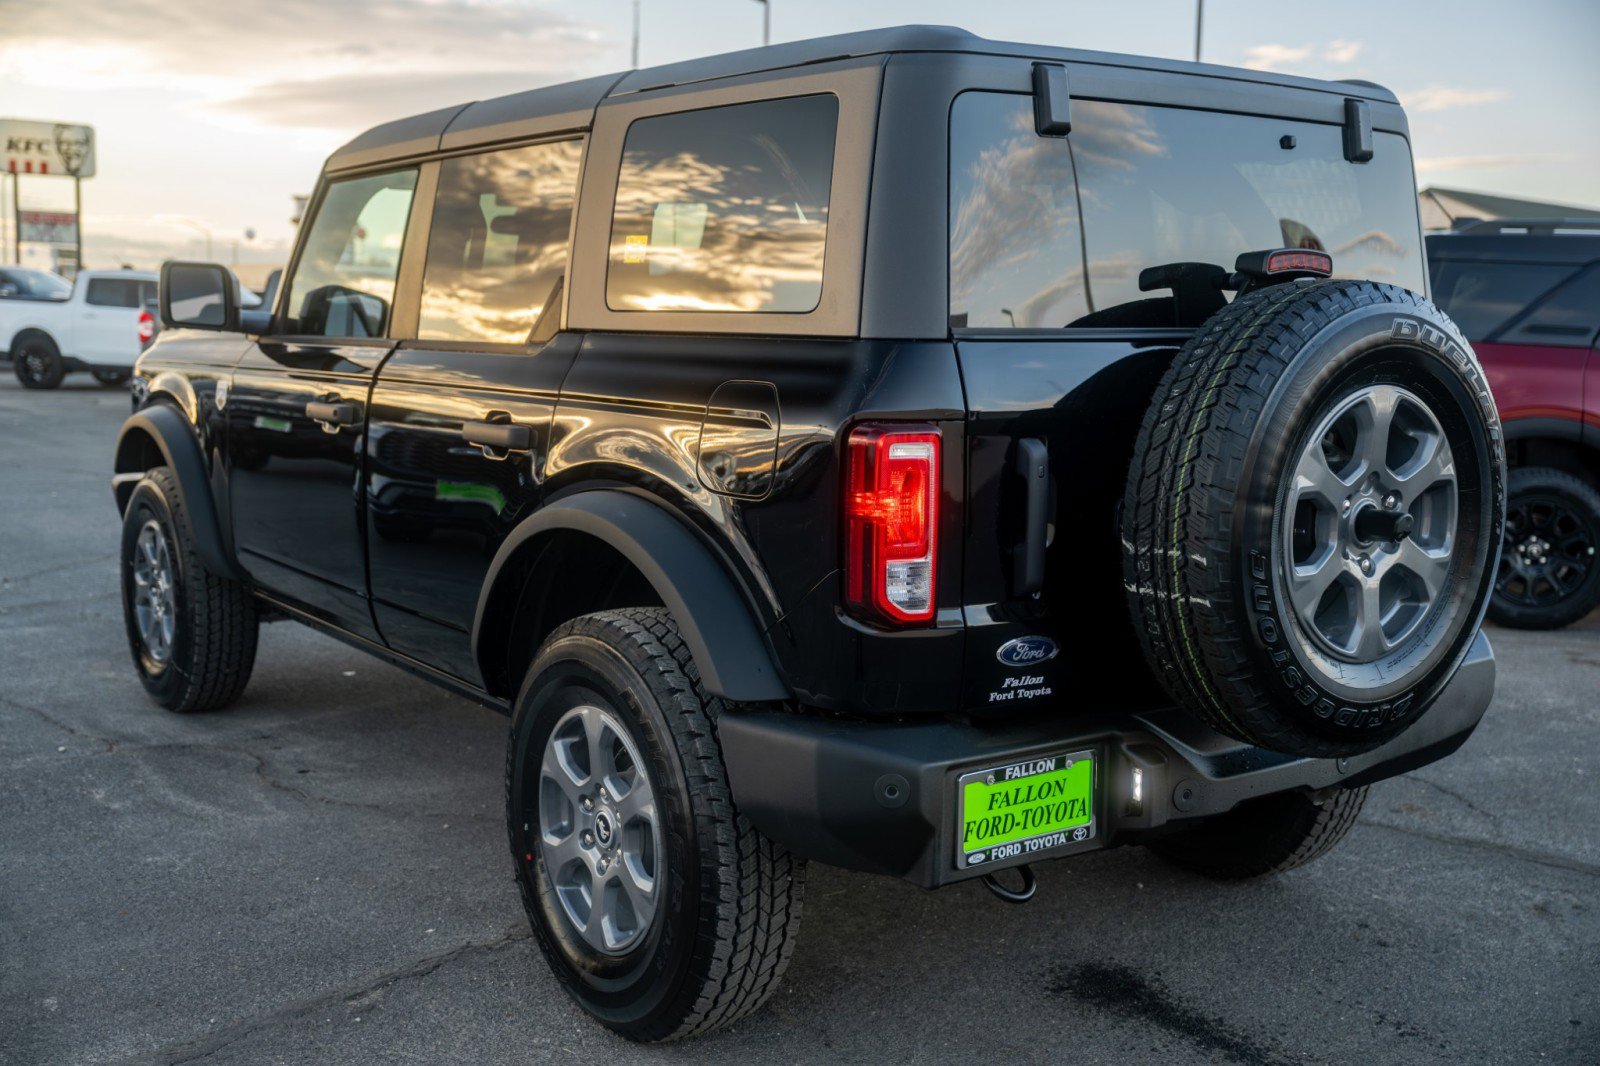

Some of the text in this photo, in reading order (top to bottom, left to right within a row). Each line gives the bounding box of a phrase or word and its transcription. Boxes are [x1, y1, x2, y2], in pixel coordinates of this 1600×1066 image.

[7, 136, 50, 156] KFC
[1391, 318, 1503, 462] DUELER
[1251, 549, 1414, 728] BRIDGESTONE
[1013, 642, 1046, 661] Ford
[1002, 675, 1044, 688] Fallon
[989, 686, 1052, 702] Ford Toyota
[1005, 759, 1056, 780] FALLON
[987, 778, 1067, 811] FALLON
[964, 797, 1087, 843] FORD-TOYOTA
[991, 844, 1021, 860] FORD
[1026, 832, 1066, 852] TOYOTA
